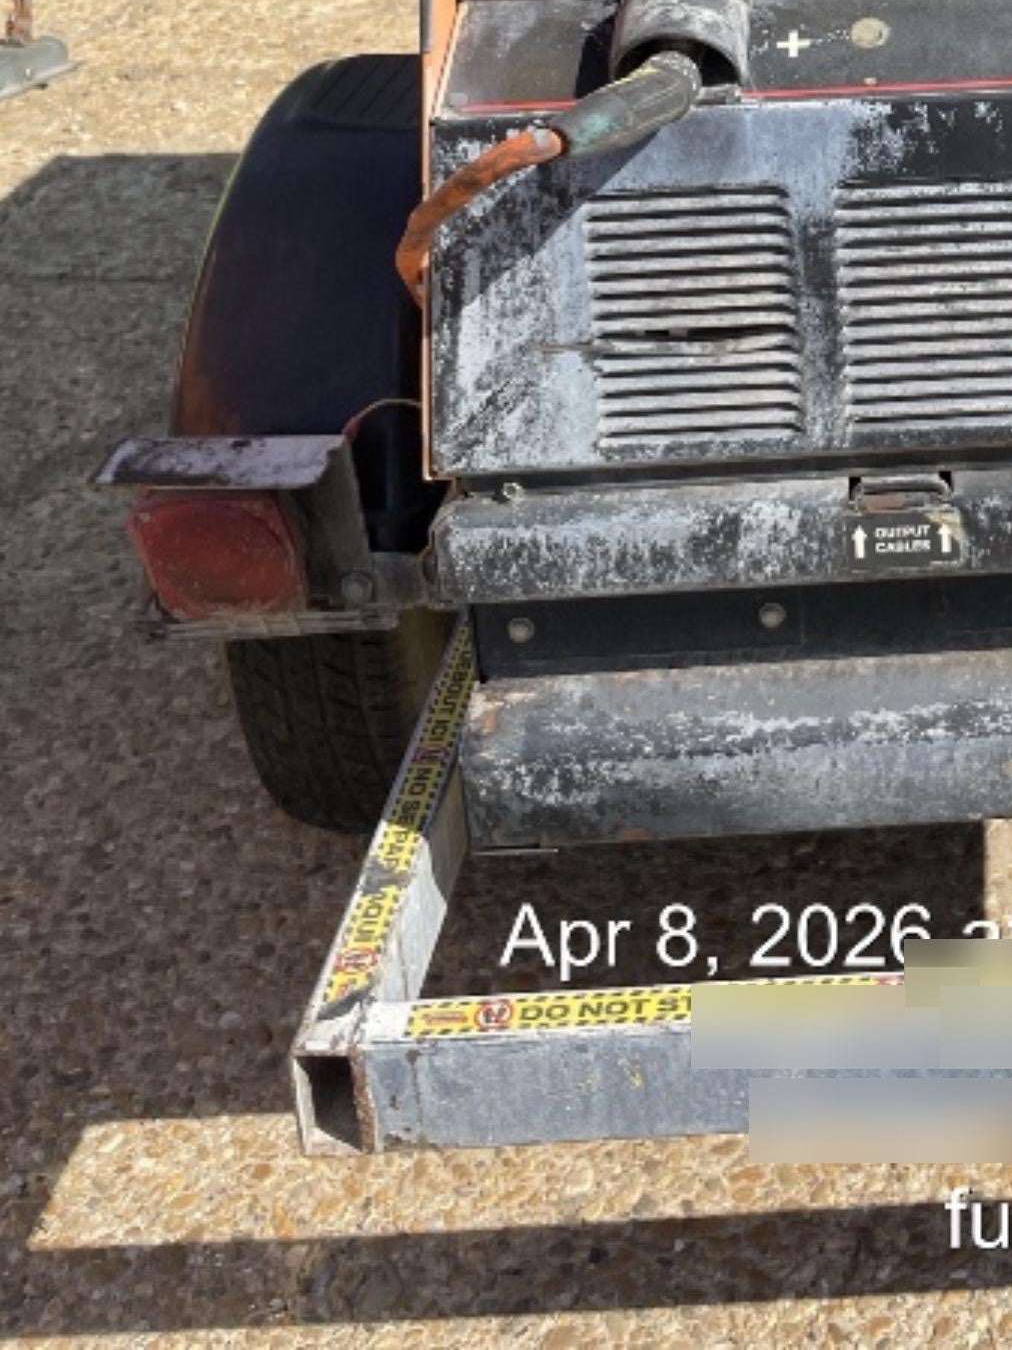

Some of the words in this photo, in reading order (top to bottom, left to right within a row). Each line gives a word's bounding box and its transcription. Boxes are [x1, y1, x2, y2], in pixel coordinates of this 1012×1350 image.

[875, 523, 931, 538] OUTPUT
[875, 539, 931, 553] CABLES
[519, 1002, 572, 1022] DO
[577, 998, 647, 1019] NOT
